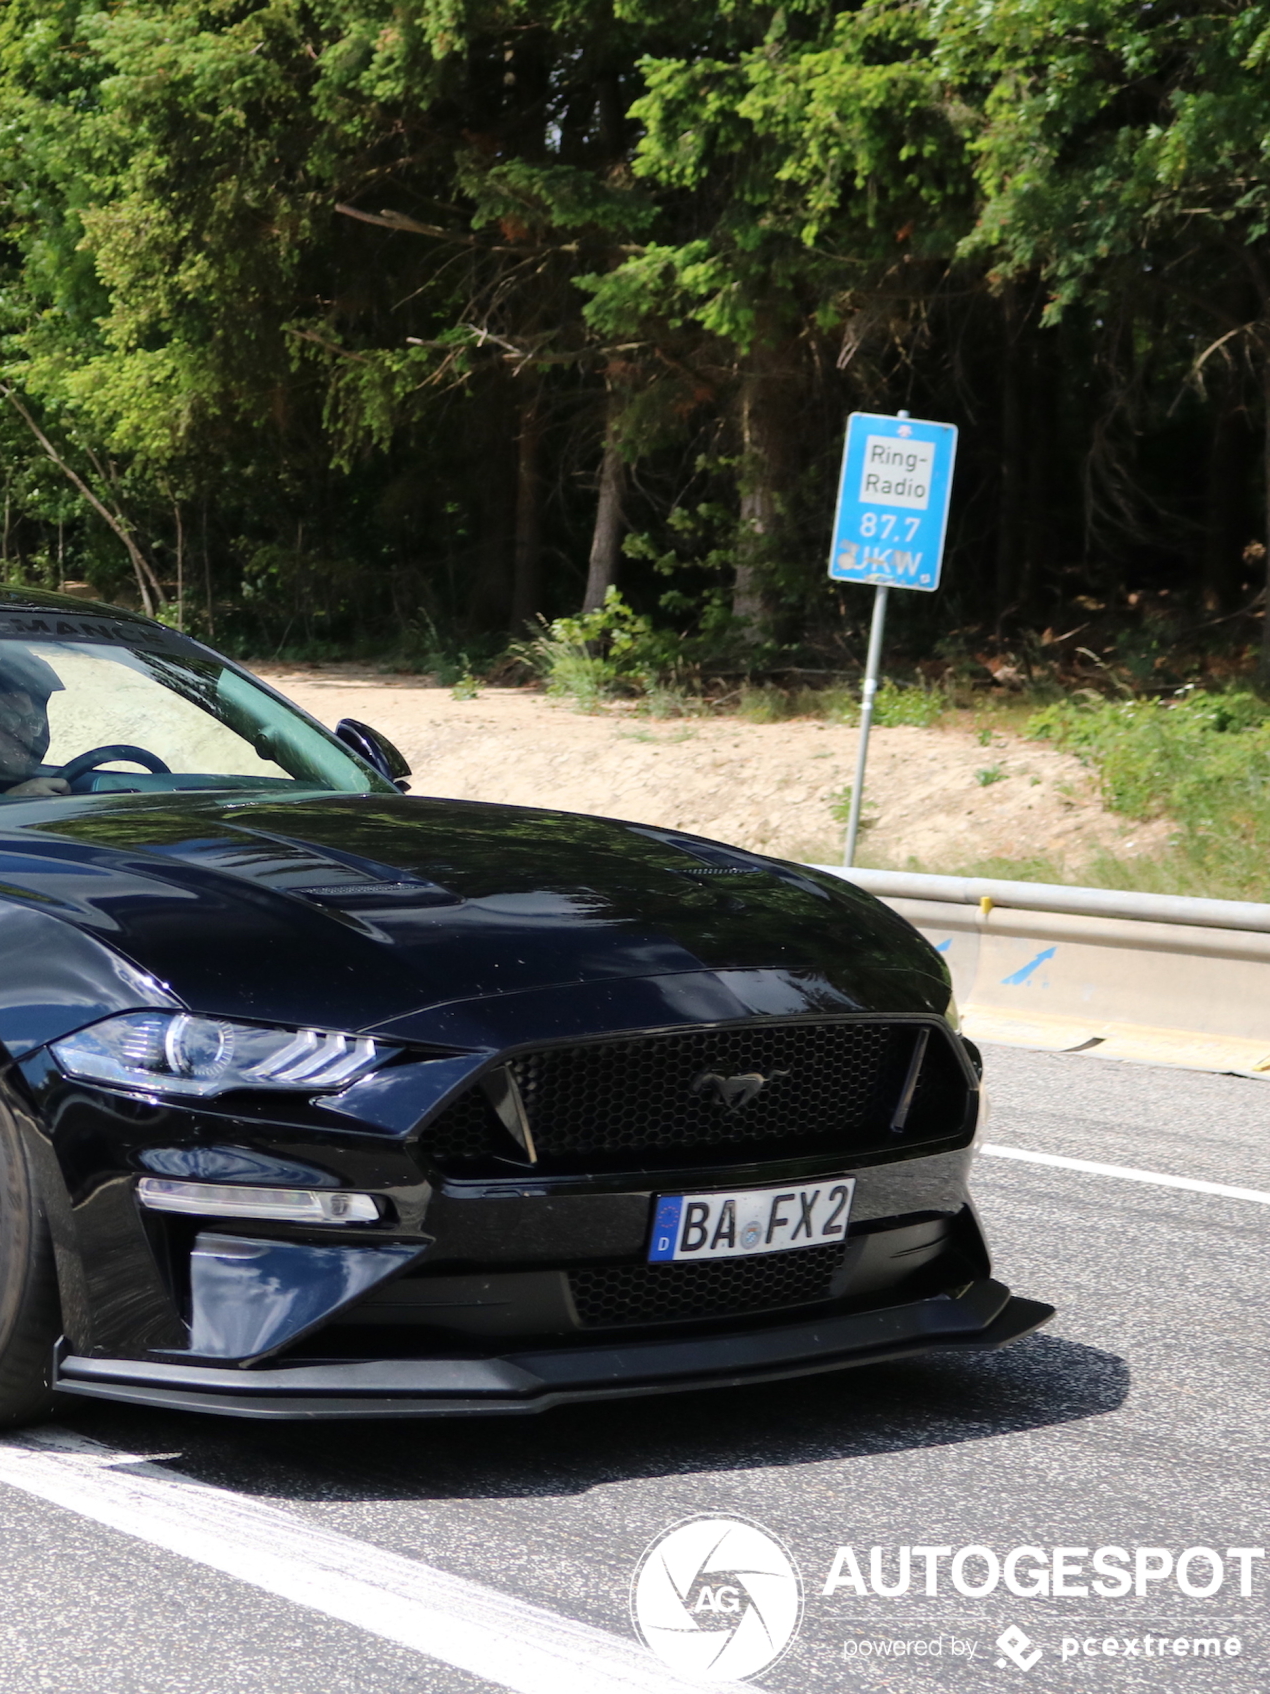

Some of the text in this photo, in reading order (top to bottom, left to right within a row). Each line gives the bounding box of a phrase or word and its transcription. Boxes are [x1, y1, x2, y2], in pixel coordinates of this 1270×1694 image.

[870, 444, 929, 472] Ring-
[865, 473, 927, 498] Radio
[859, 512, 921, 542] 87.7
[680, 1199, 736, 1252] BA
[658, 1237, 669, 1251] D
